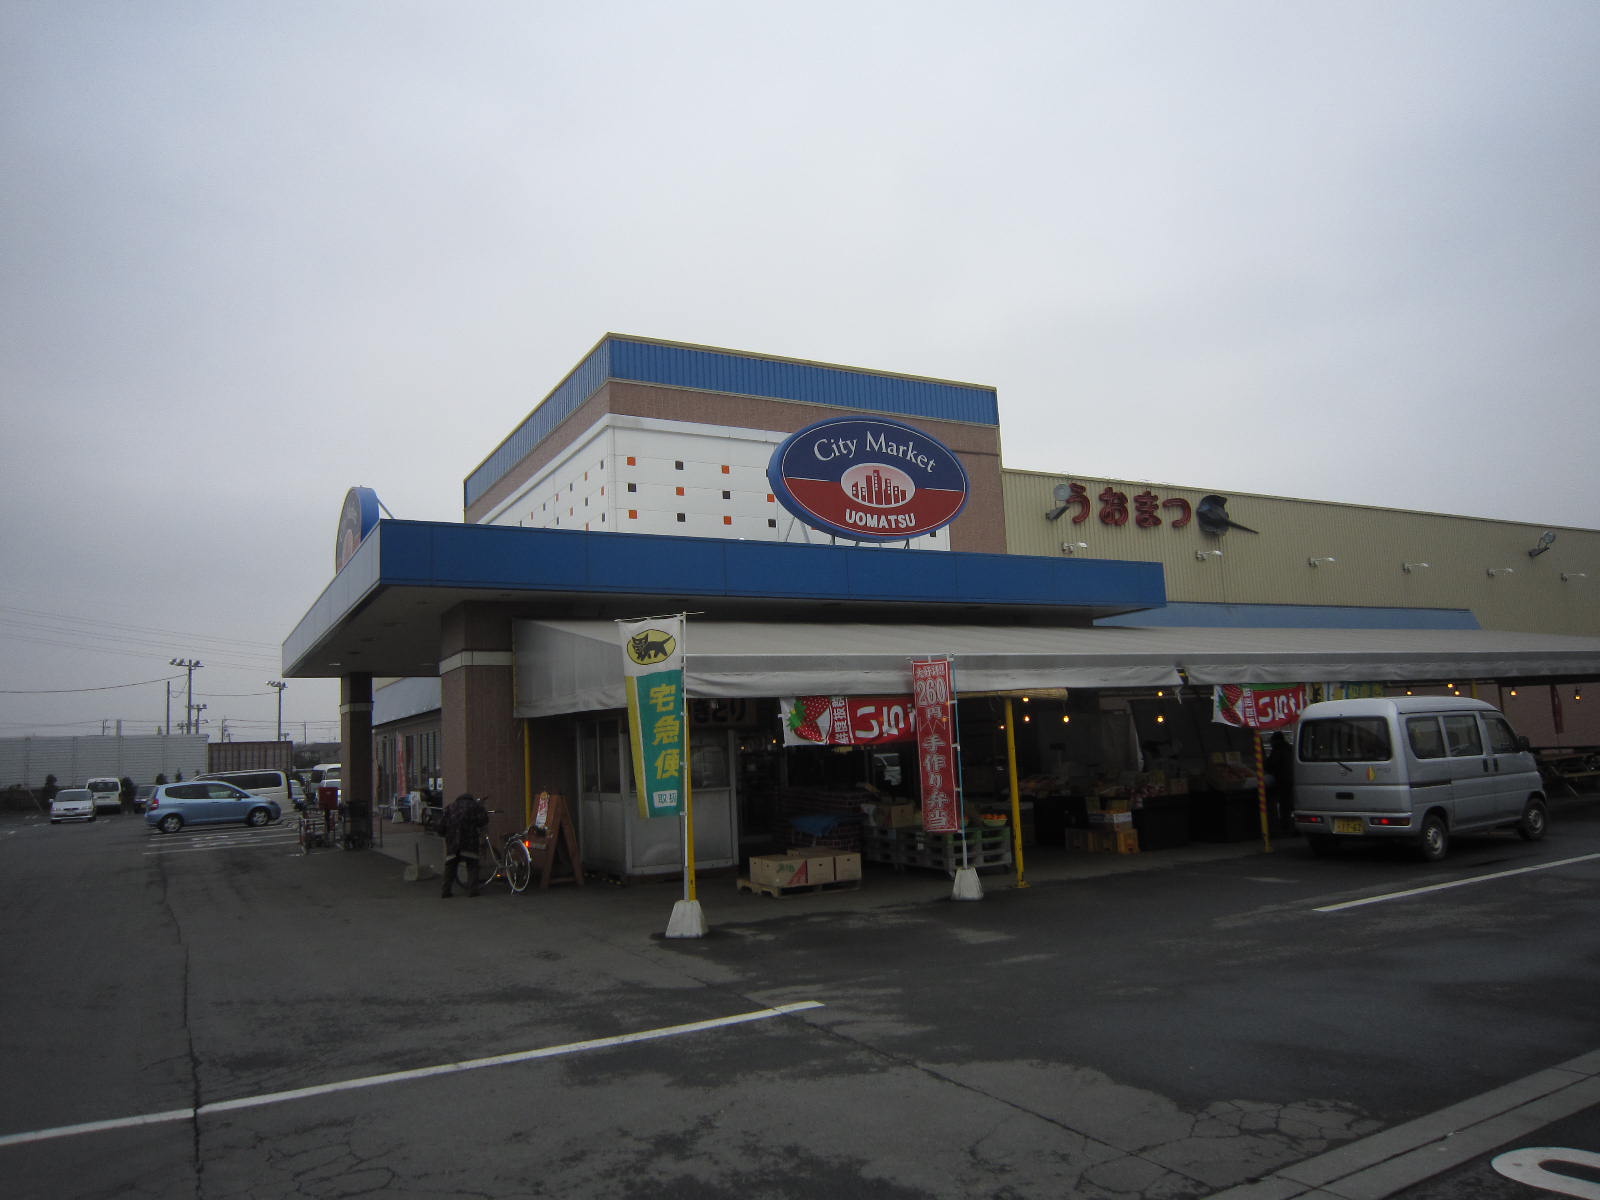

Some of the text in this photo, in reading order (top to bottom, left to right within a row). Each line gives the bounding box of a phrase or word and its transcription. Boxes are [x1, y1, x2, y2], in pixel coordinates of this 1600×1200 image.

[813, 430, 936, 473] City Market
[845, 508, 916, 529] UOMATSU
[1066, 482, 1192, 528] うおまつ
[650, 683, 681, 780] 宅急便
[922, 735, 949, 827] 手作り弁当
